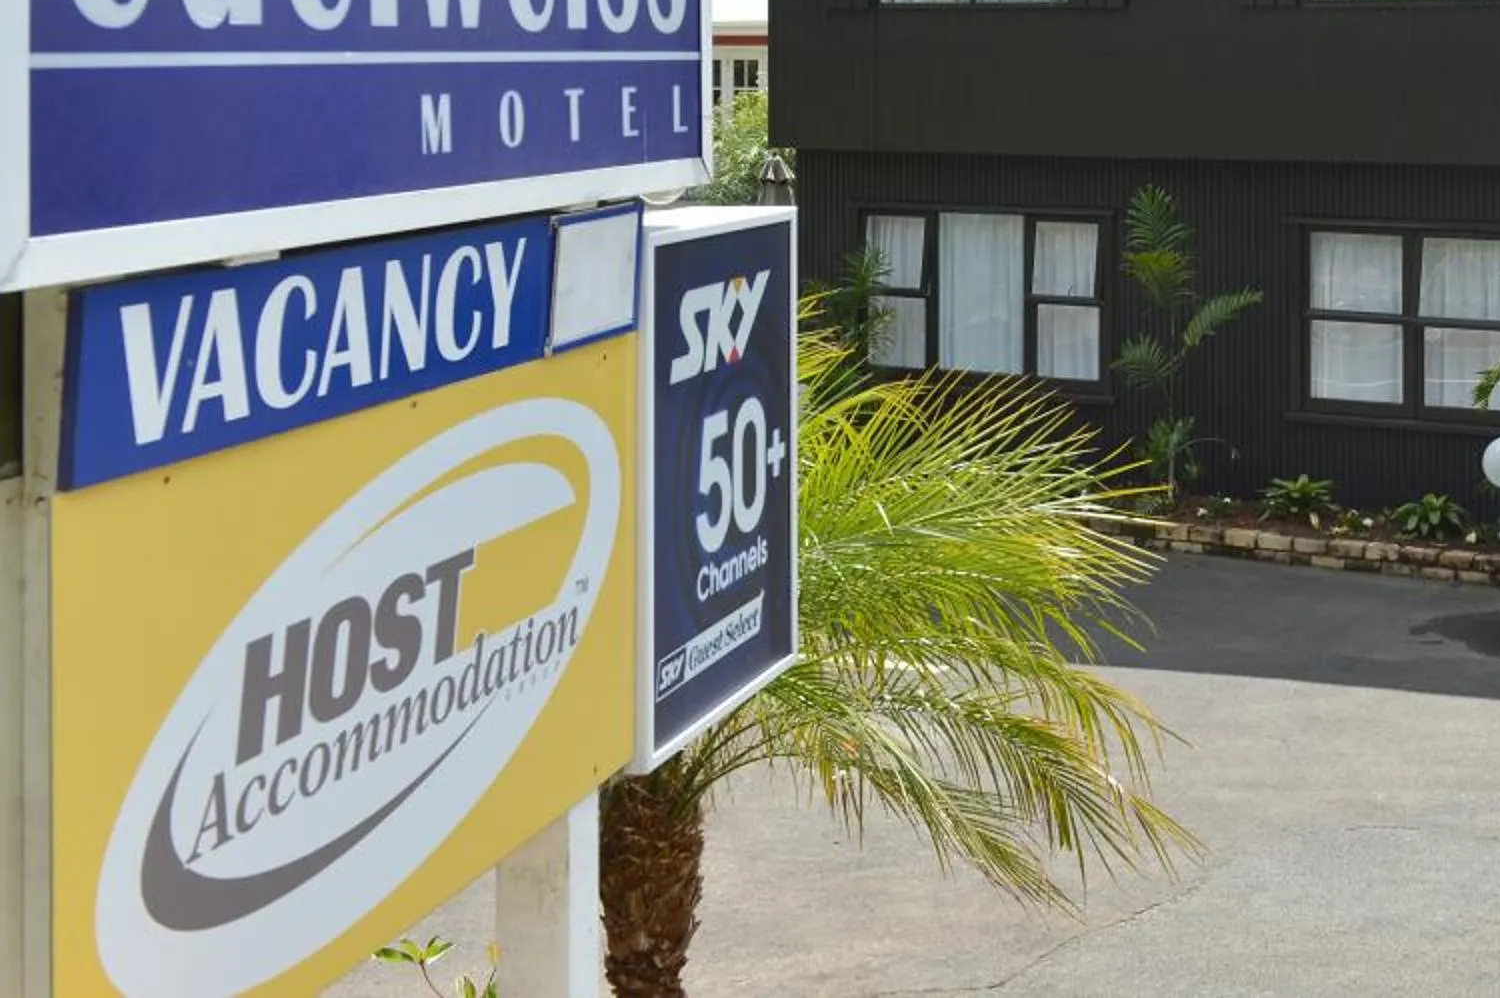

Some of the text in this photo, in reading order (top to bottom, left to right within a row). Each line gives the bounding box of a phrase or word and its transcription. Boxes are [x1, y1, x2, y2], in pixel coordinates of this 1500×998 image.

[420, 85, 689, 155] MOTEL
[119, 237, 527, 446] VACANCY
[669, 269, 771, 385] SKY
[696, 397, 785, 553] 50+
[697, 534, 769, 603] Channels
[235, 547, 475, 766] HOST
[659, 608, 759, 691] SKY Guest Select
[185, 605, 579, 864] Accommodation
